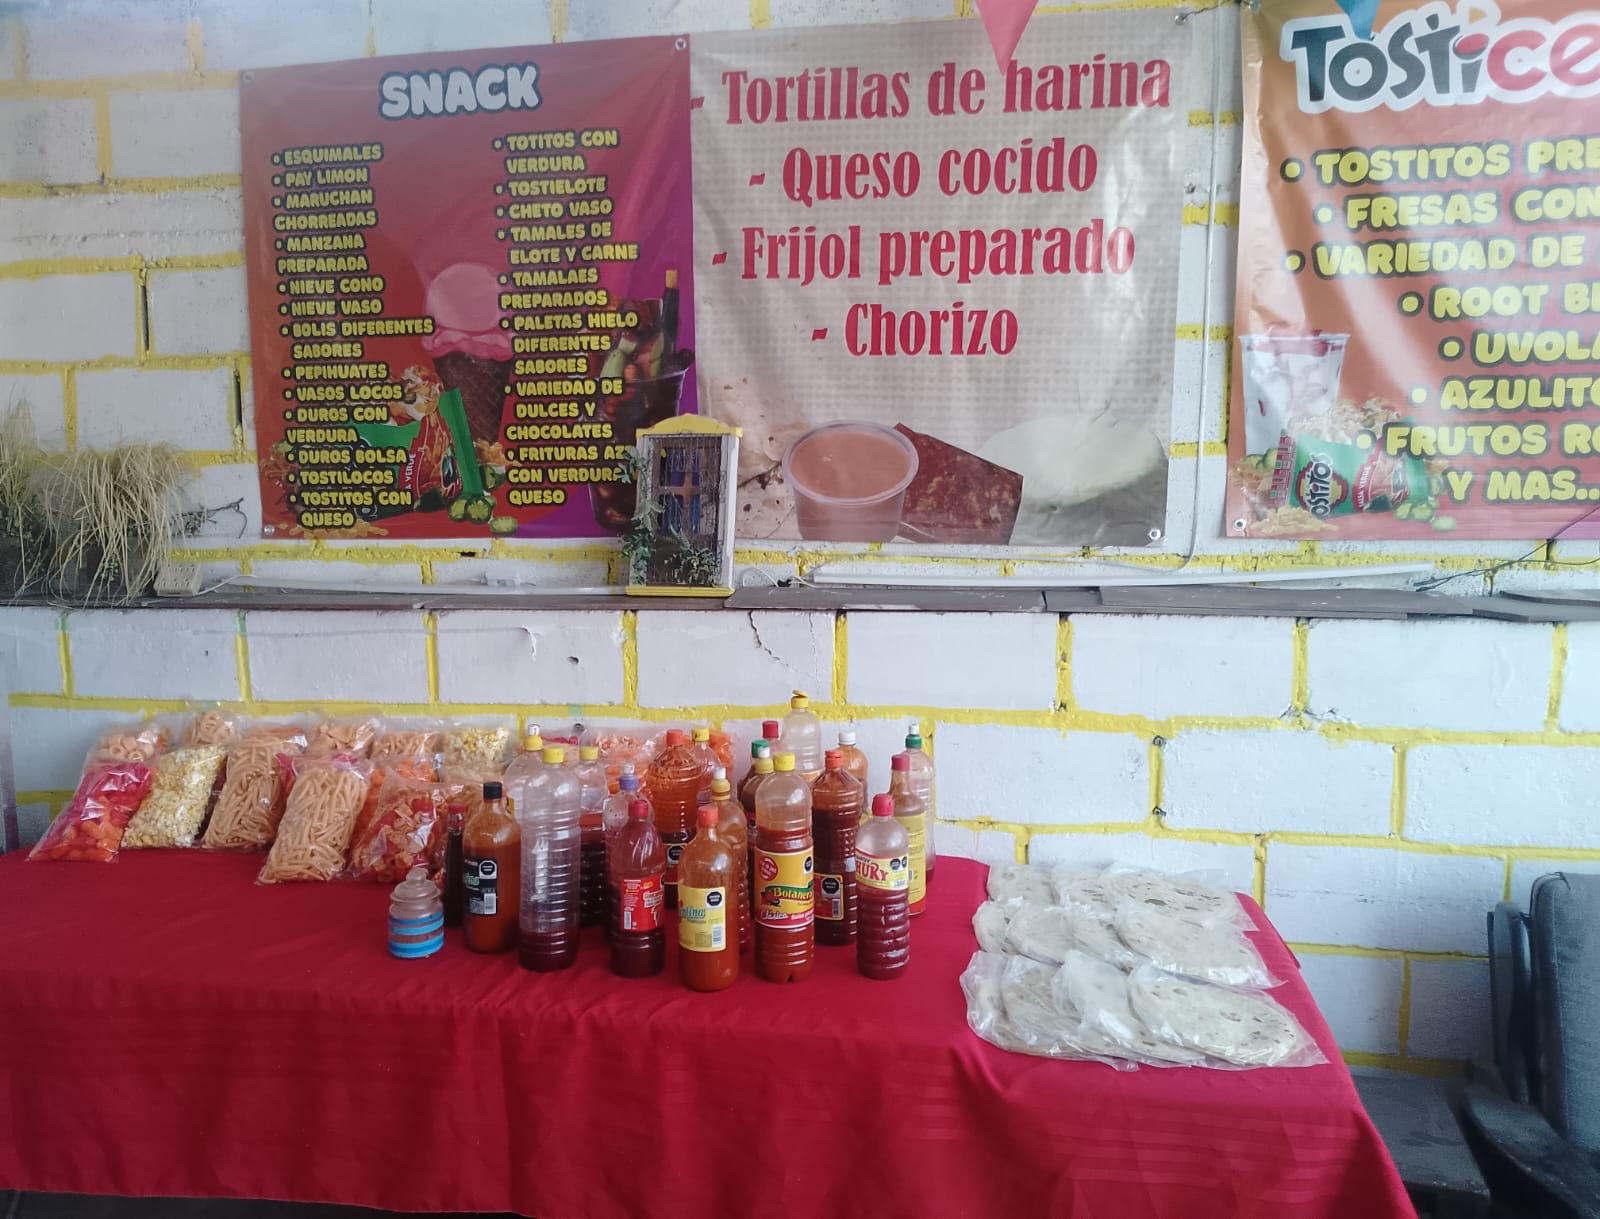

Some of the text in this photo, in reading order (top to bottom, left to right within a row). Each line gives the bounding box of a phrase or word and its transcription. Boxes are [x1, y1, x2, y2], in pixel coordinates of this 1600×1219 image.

[381, 64, 540, 118] SNACK
[721, 66, 911, 125] Tortillas
[927, 61, 986, 117] de
[1002, 54, 1171, 114] harina
[506, 129, 618, 151] TOTITOS CON
[284, 145, 382, 165] ESQUIMALES
[506, 155, 585, 174] VERDURA
[1315, 143, 1511, 184] TOSTITOS
[285, 168, 368, 187] PAY LIMON
[782, 146, 921, 208] Queso
[938, 137, 1098, 197] cocido
[508, 177, 606, 196] TOSTIELOTE
[286, 189, 374, 208] MARUCHAN
[1346, 185, 1600, 229] FRESAS CON
[508, 199, 612, 219] CHETO VASO
[274, 210, 377, 230] CHORREADAS
[510, 221, 612, 241] TAMALES DE
[287, 234, 365, 251] MANZANA
[510, 244, 639, 264] ELOTE Y CARNE
[740, 225, 861, 287] Frijol
[877, 219, 1135, 285] preparado
[1316, 235, 1586, 276] VARIEDAD DE
[278, 256, 368, 273] PREPARADA
[289, 277, 384, 294] NIEVE CONO
[512, 267, 598, 286] TAMALAES
[291, 299, 383, 316] NIEVE VASO
[500, 290, 608, 309] PREPARADOS
[1433, 284, 1549, 319] ROOT
[292, 319, 433, 338] BOLIS DIFERENTES
[513, 312, 639, 331] PALETAS HIELO
[844, 301, 1018, 356] Chorizo
[293, 343, 362, 359] SABORES
[513, 336, 611, 353] DIFERENTES
[514, 358, 588, 375] SABORES
[296, 385, 402, 402] VASOS LOCOS
[516, 379, 623, 396] VARIEDAD DE
[297, 407, 388, 422] DUROS CON
[516, 402, 596, 418] DULCES Y
[286, 428, 358, 444] VERDURA
[506, 424, 613, 440] CHOCOLATES
[1386, 423, 1600, 456] FRUTOS R
[298, 449, 407, 464] DUROS BOLSA
[519, 446, 599, 461] FRITURAS
[300, 470, 394, 485] TOSTILOCOS
[508, 469, 543, 483] CON
[1448, 470, 1473, 500] Y
[301, 491, 412, 506] TOSTITOS CON
[509, 490, 565, 506] QUESO
[301, 512, 354, 527] QUESO
